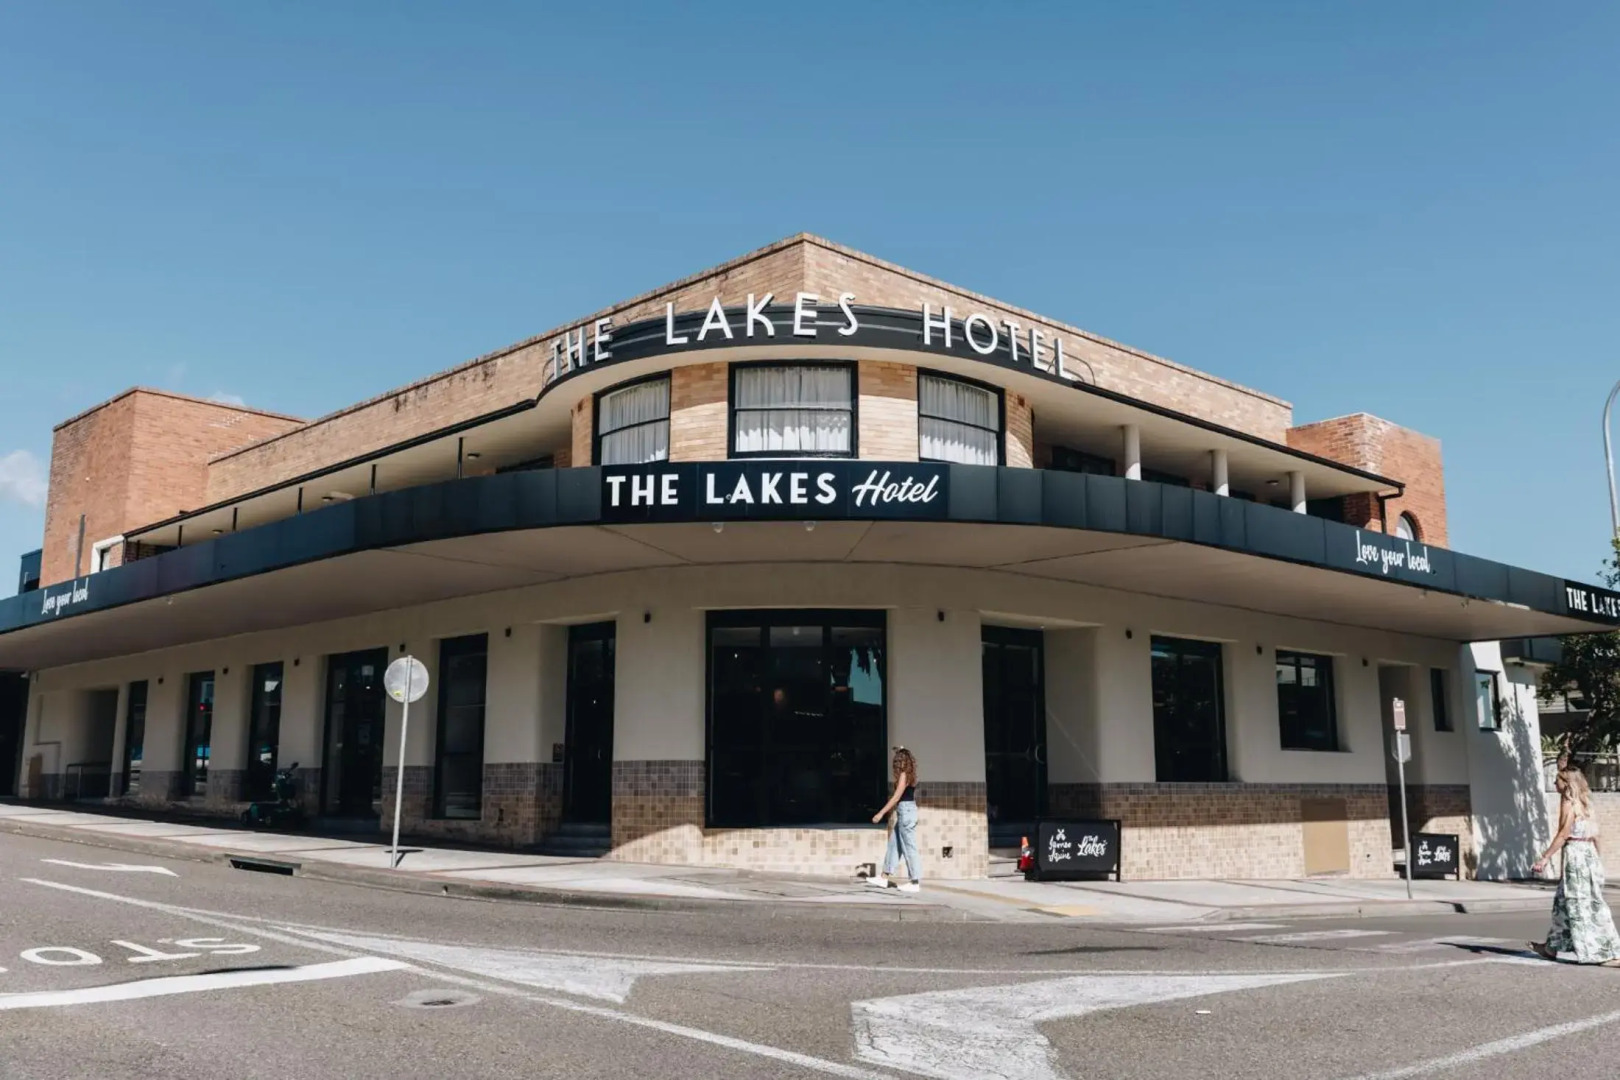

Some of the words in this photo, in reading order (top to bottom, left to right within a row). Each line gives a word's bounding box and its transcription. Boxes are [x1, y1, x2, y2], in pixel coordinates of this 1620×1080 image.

[550, 317, 613, 381] THE
[666, 291, 858, 346] LAKES
[922, 302, 1074, 381] HOTEL
[606, 474, 679, 507] THE
[706, 472, 837, 505] LAKES
[852, 469, 939, 508] Hotel
[1356, 529, 1379, 566] Love
[1381, 549, 1405, 575] your
[1406, 541, 1430, 573] local
[1566, 587, 1588, 611] THE
[0, 938, 262, 973] STO
